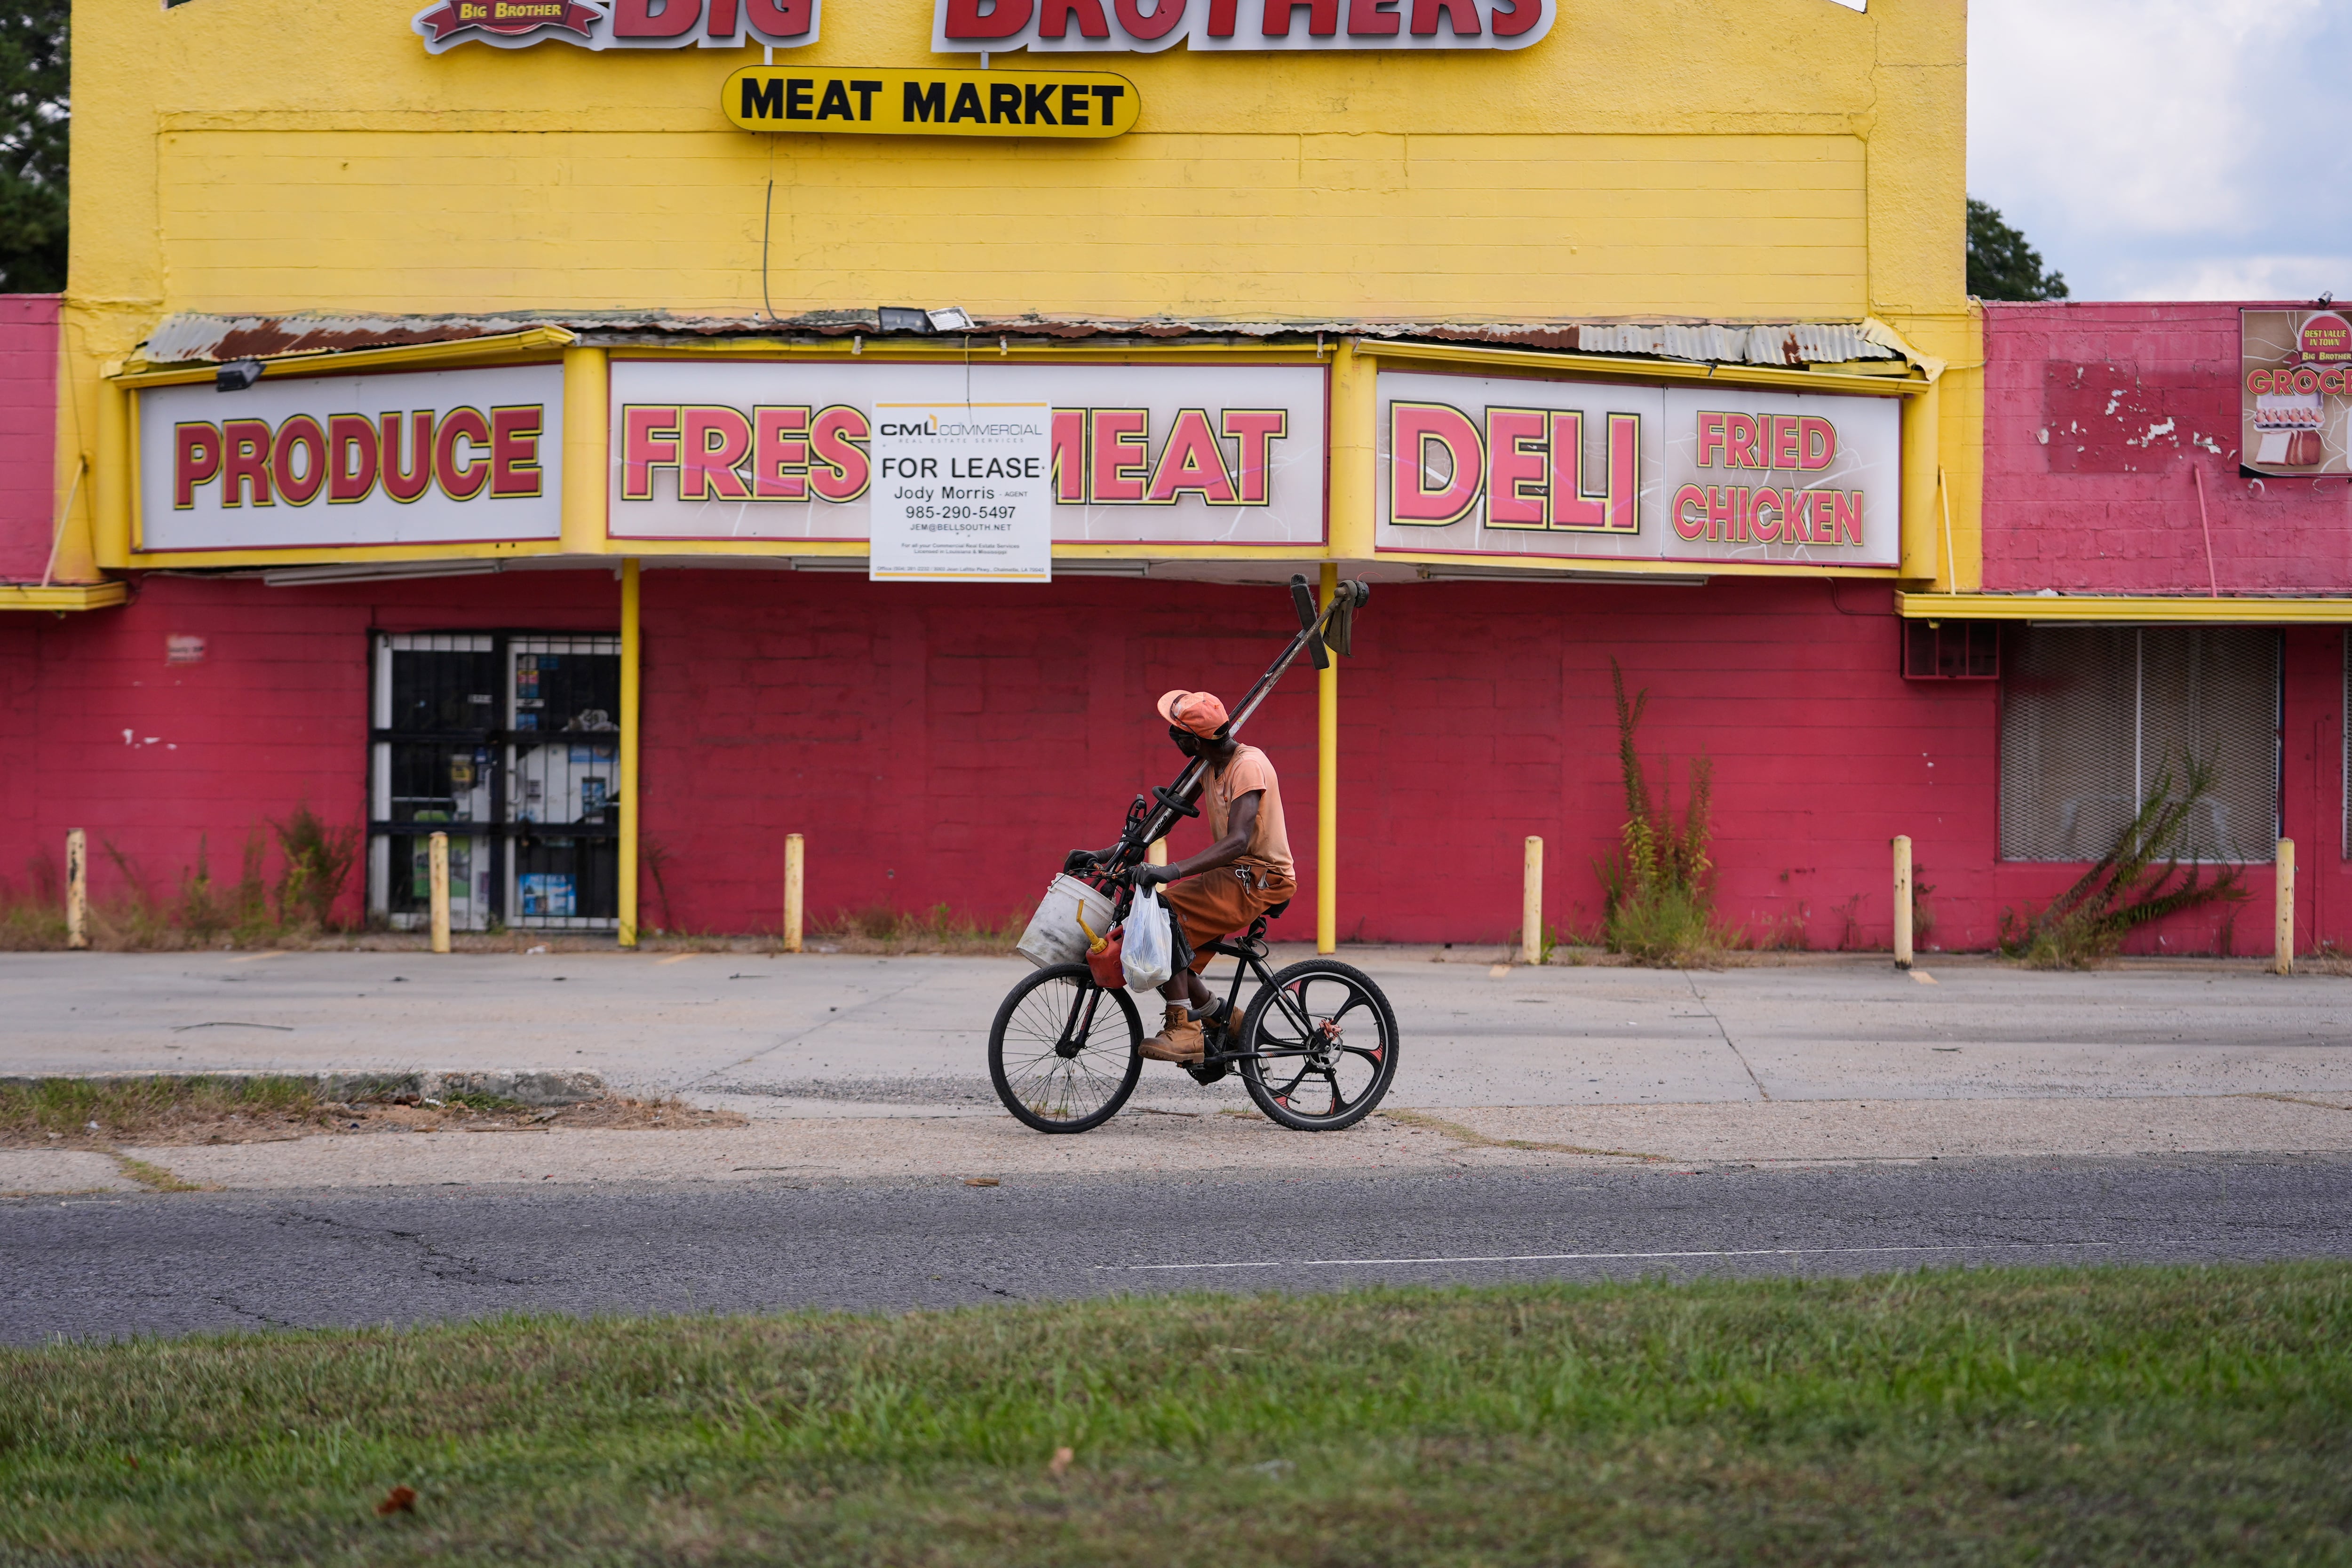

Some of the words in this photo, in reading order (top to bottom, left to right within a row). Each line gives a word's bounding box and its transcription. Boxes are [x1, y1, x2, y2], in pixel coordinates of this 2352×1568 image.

[742, 78, 882, 121] MEAT
[903, 81, 1124, 126] MARKET
[621, 404, 871, 503] FRES
[881, 420, 937, 435] CML
[940, 424, 1043, 435] COMMERCIAL
[1696, 410, 1837, 471] FRIED
[174, 404, 544, 510] PRODUCE
[882, 458, 938, 478] FOR
[951, 458, 1040, 478] LEASE
[1389, 399, 1641, 534] DELI
[894, 486, 934, 502] Jody
[941, 486, 994, 499] Morris
[906, 506, 1016, 518] 985-290-5497
[1671, 483, 1864, 546] CHICKEN
